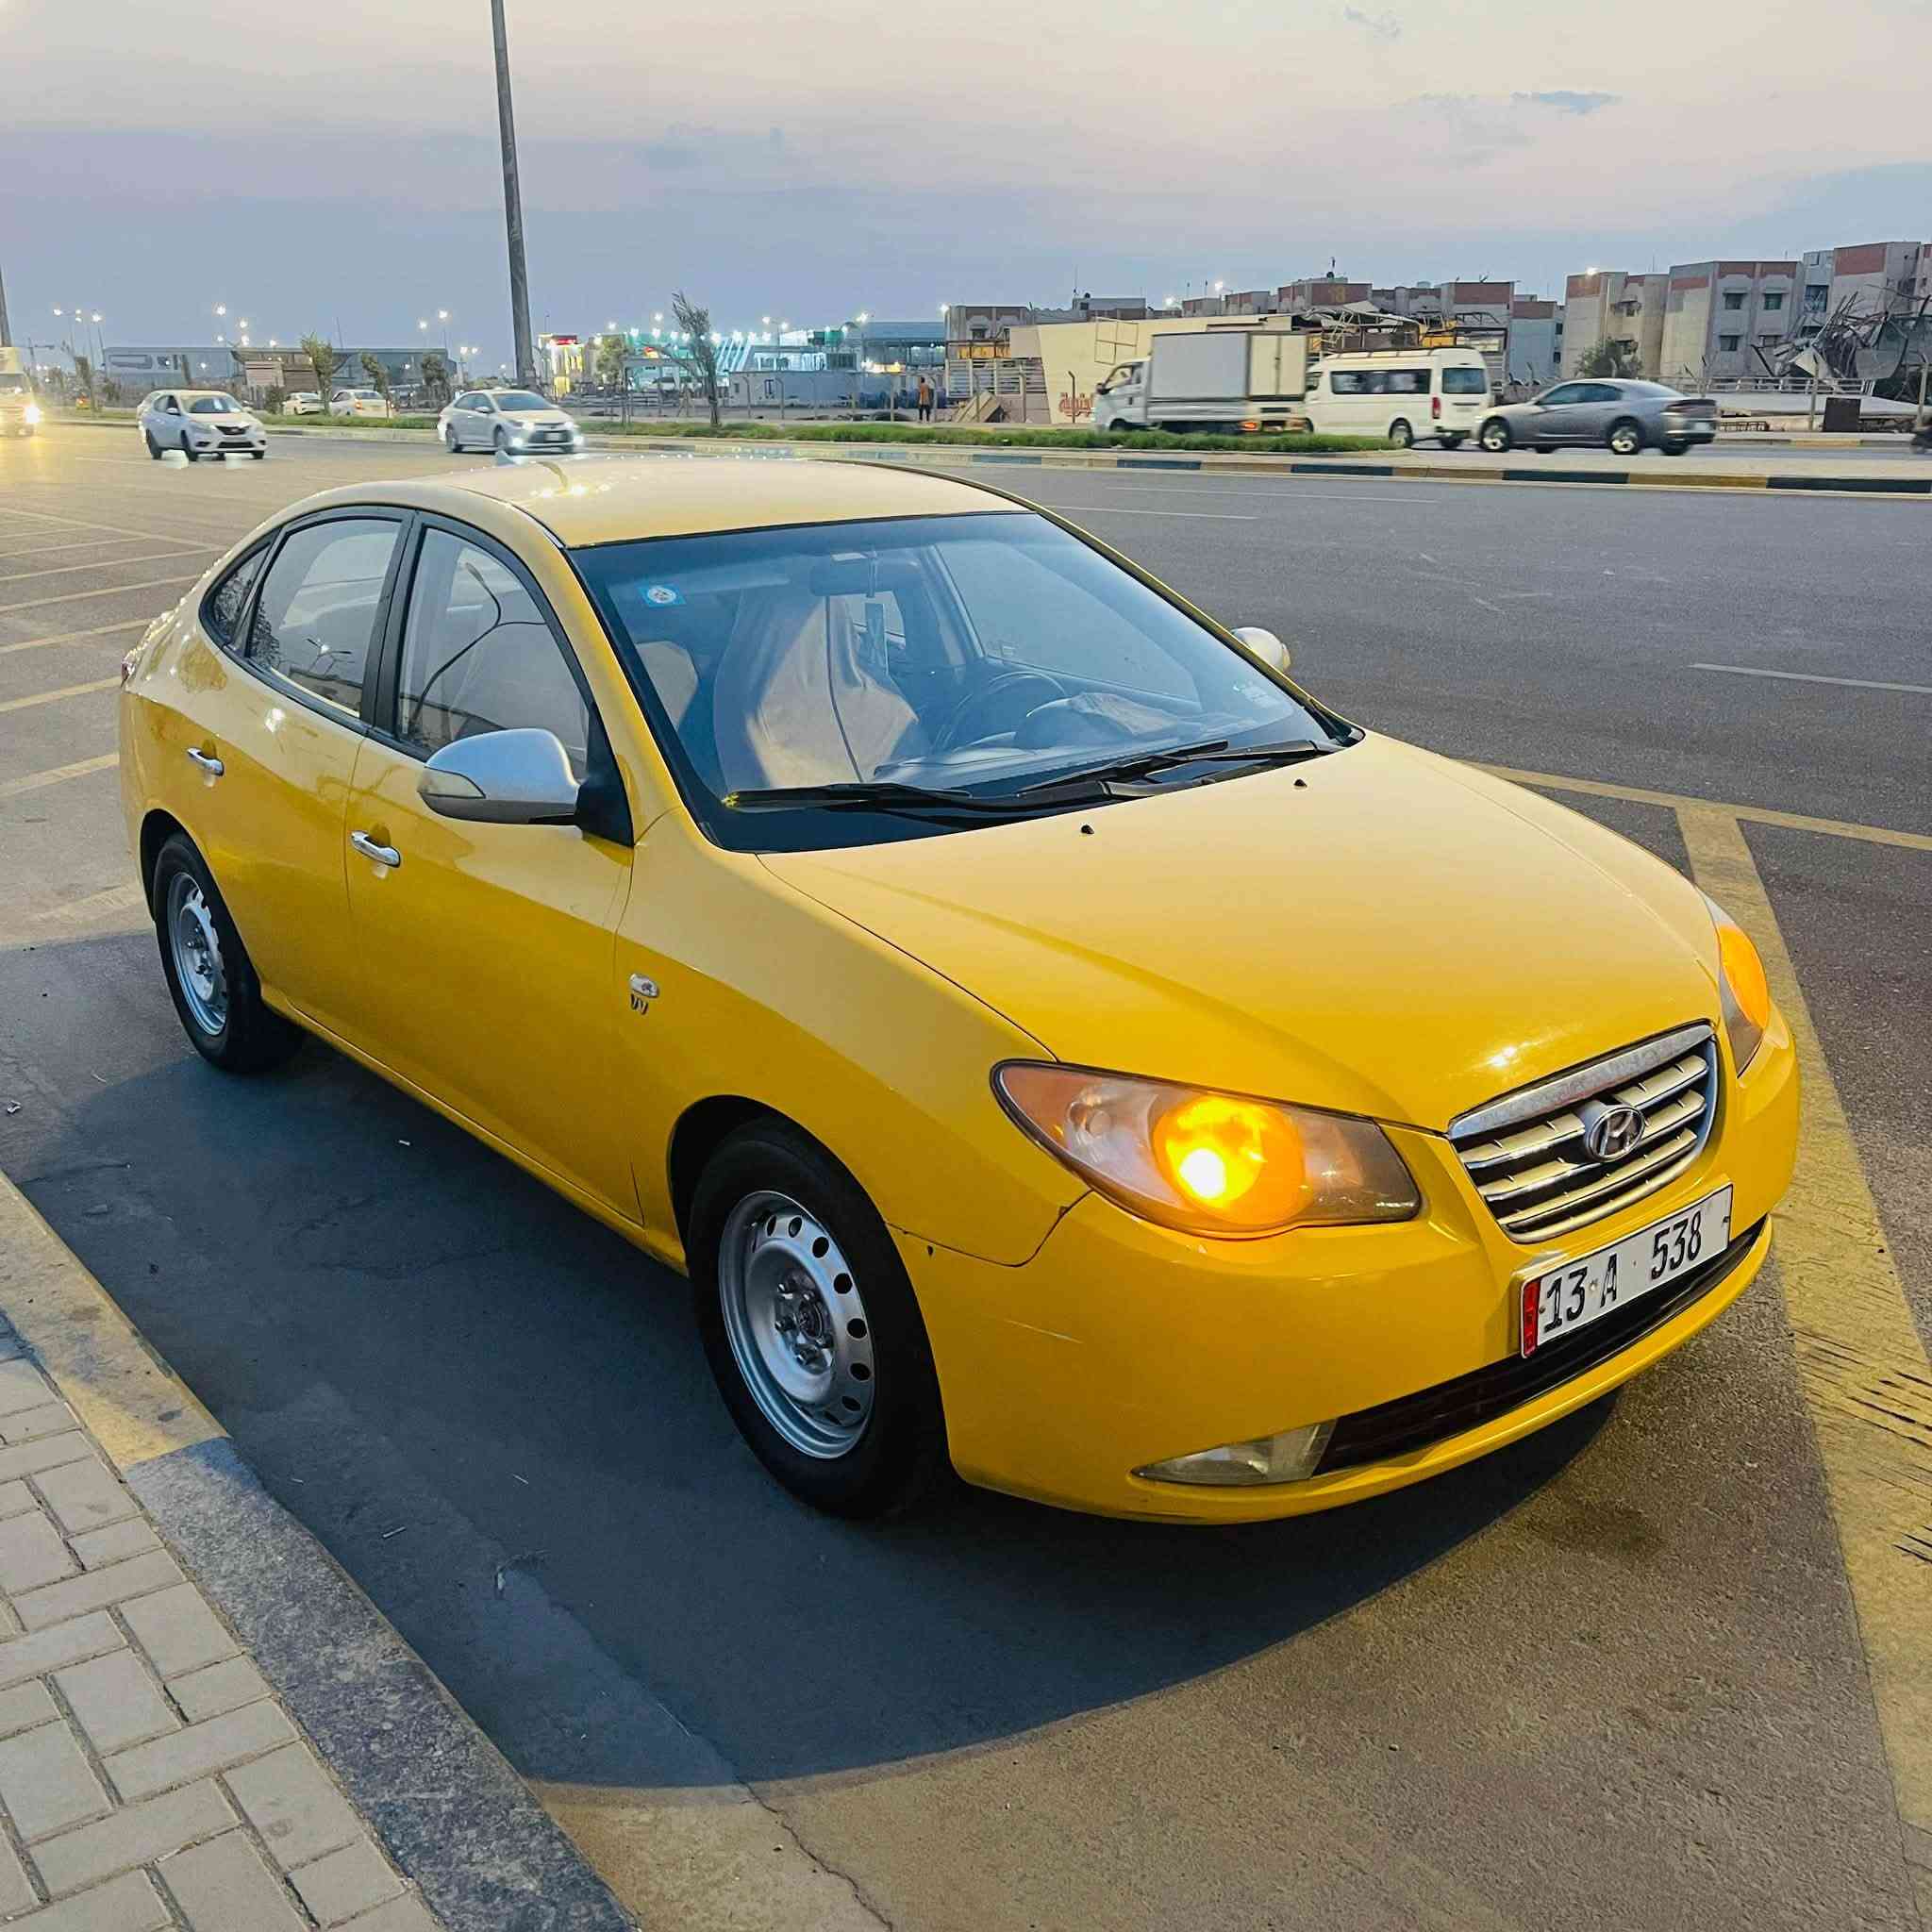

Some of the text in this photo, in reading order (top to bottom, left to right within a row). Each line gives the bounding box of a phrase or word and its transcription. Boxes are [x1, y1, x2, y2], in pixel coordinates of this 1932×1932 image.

[1544, 1211, 1702, 1333] 13 A 538
